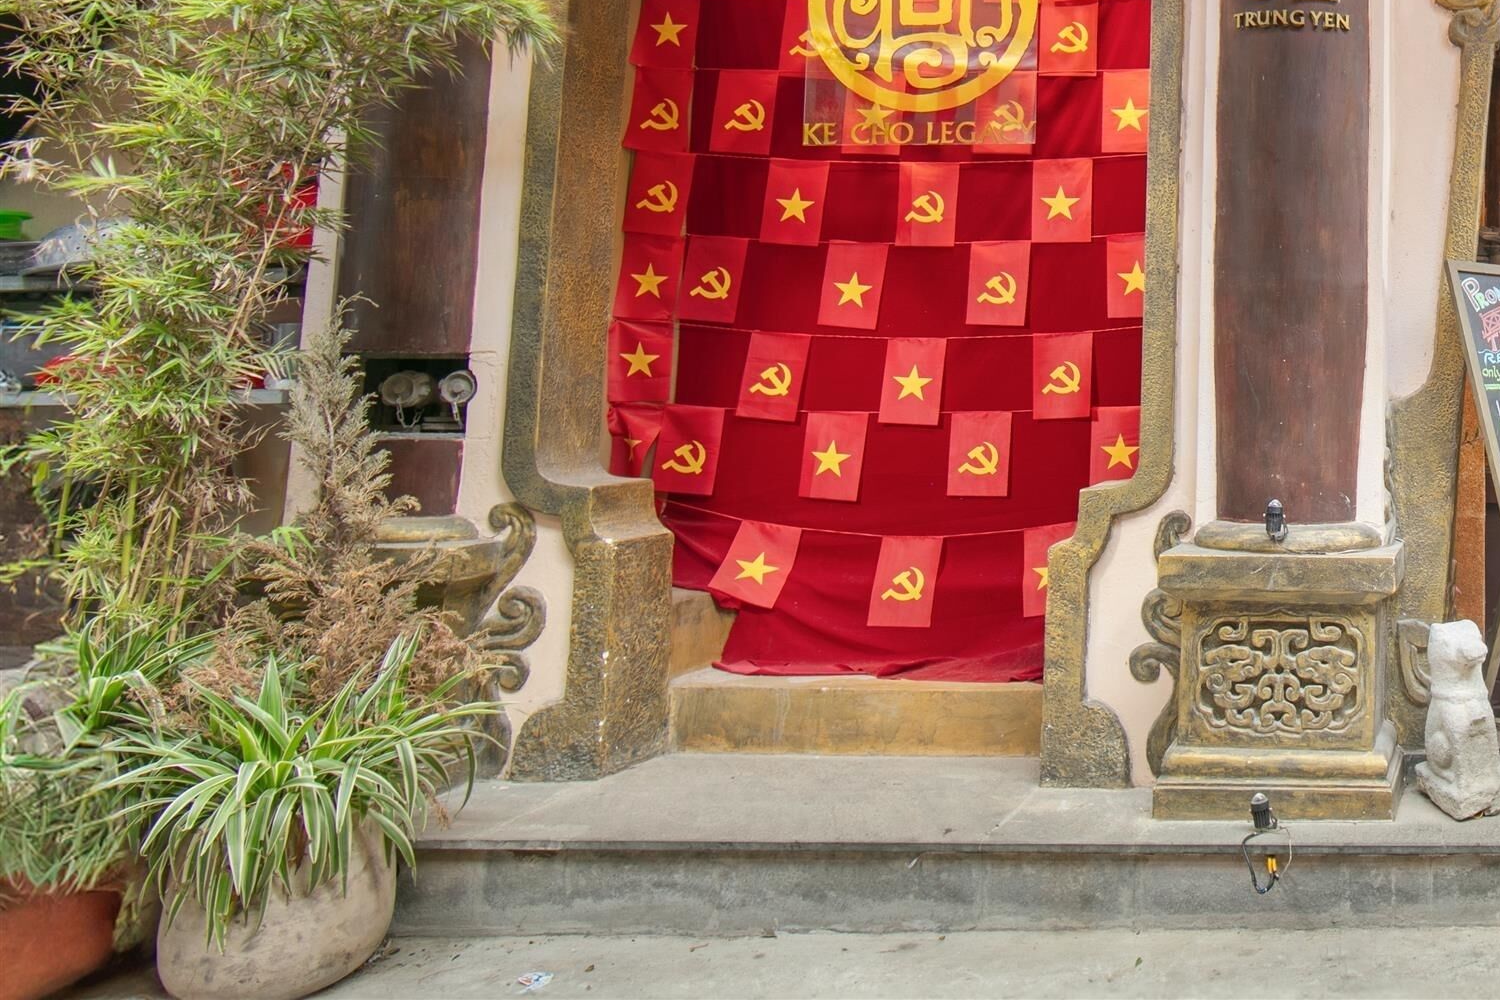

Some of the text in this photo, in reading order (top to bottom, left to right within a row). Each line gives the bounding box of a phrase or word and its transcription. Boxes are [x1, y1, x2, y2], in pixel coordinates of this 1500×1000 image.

[1233, 9, 1350, 30] TRUNG YEN
[803, 121, 1036, 146] KE CHO LEGACY
